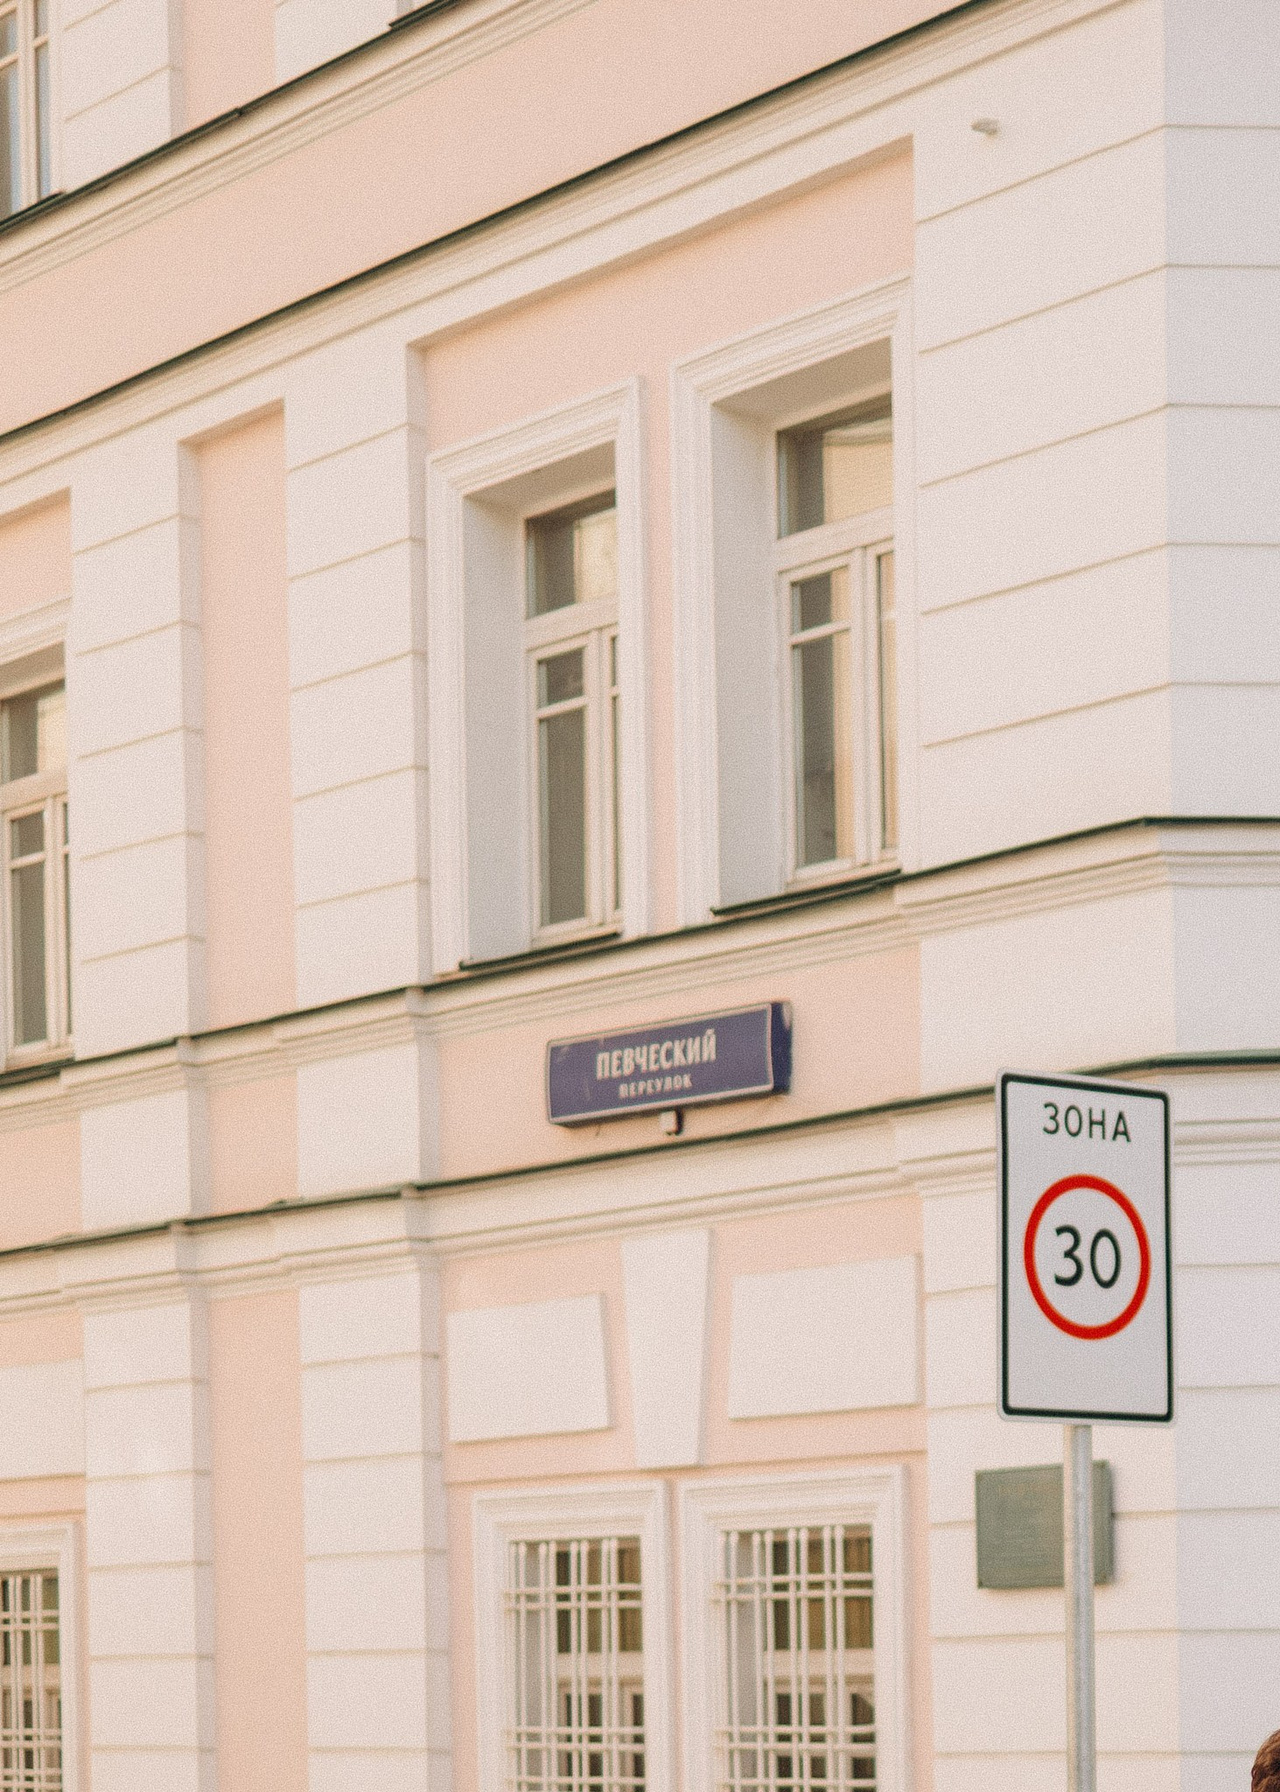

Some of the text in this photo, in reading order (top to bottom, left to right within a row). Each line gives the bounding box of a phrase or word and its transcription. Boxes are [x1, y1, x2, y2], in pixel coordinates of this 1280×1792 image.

[596, 1028, 717, 1080] ПЕВЧЕСКИЙ
[618, 1073, 693, 1099] ПЕРЕУЛОК
[1042, 1102, 1131, 1142] ЗОНА
[1054, 1224, 1122, 1289] 30
